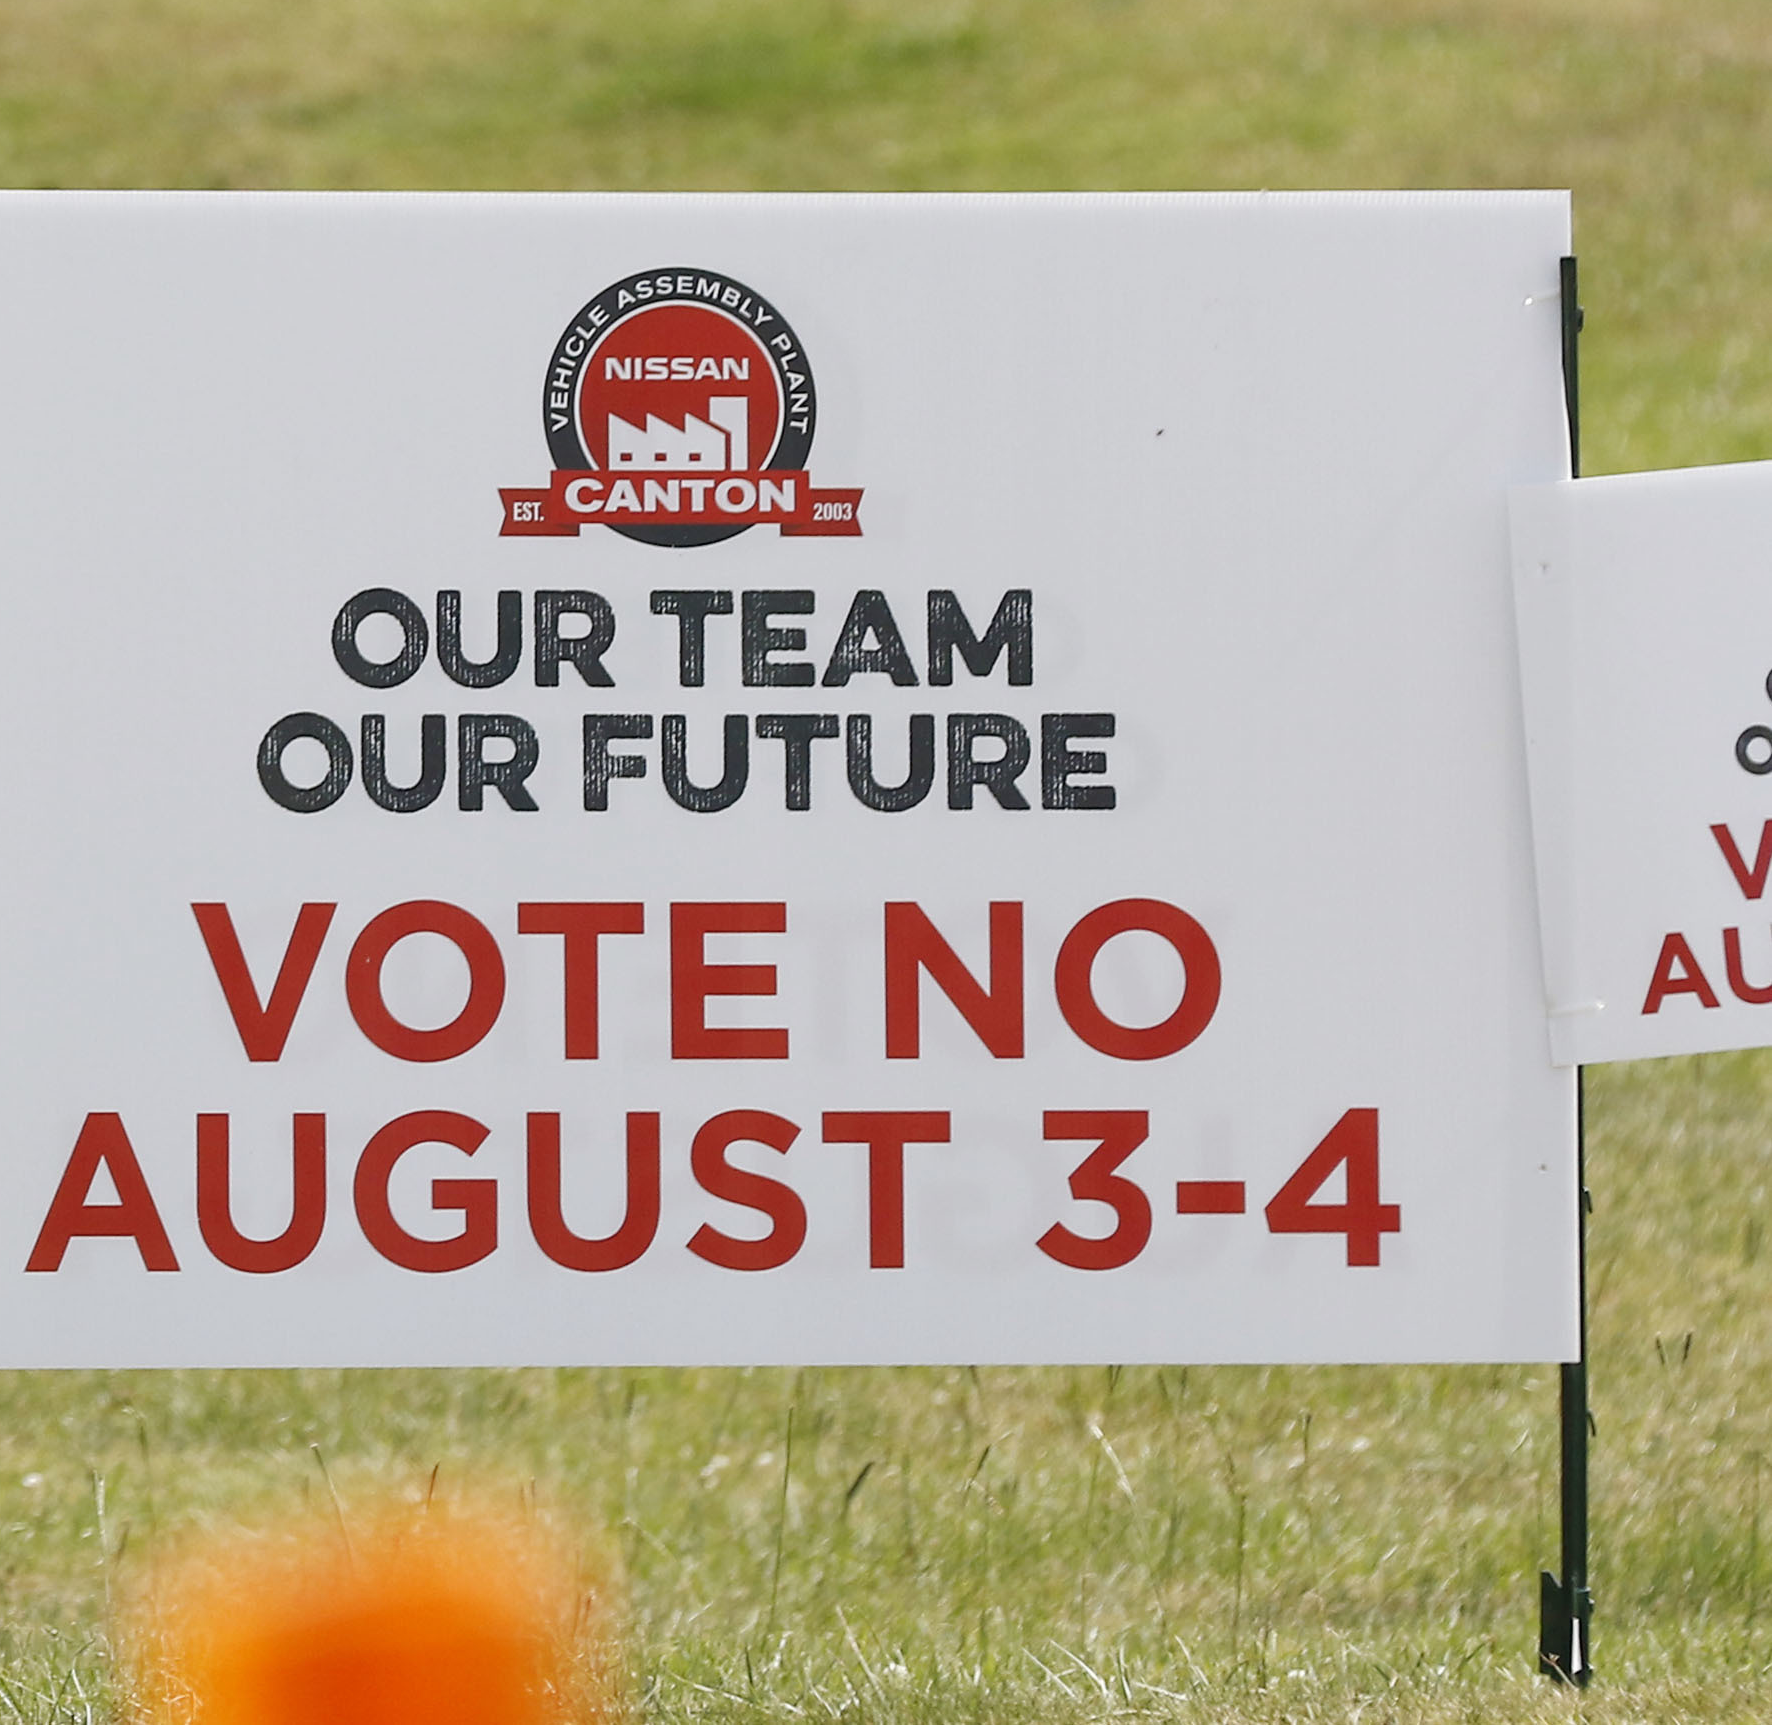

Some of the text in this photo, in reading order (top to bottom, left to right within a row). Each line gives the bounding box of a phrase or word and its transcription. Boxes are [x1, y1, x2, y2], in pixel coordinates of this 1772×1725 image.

[549, 275, 808, 435] VEHICLE ASSEMBLY PLANT
[605, 357, 749, 381] NISSAN
[513, 478, 853, 522] EST. CANTON 2003
[331, 588, 1033, 689] OUR TEAM
[257, 712, 1116, 814] OUR FUTURE
[191, 898, 1221, 1063] VOTE NO
[25, 1108, 1400, 1274] AUGUST 3-4
